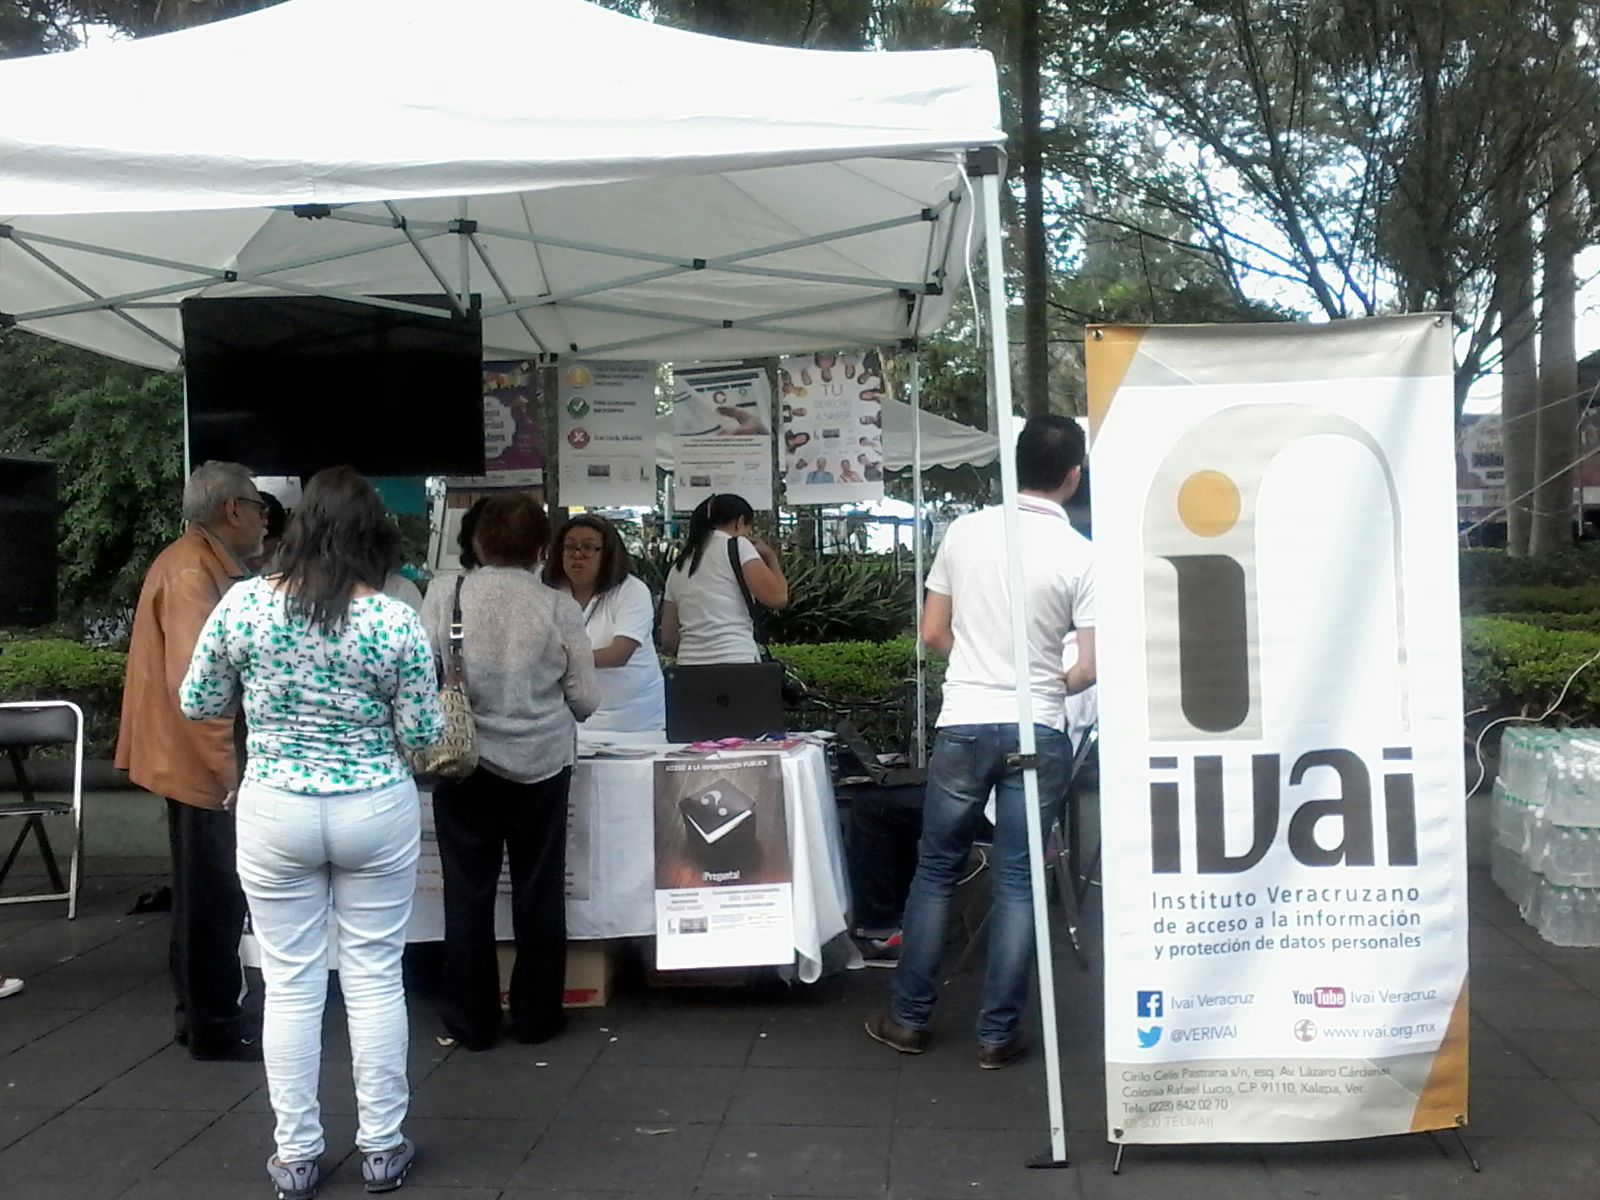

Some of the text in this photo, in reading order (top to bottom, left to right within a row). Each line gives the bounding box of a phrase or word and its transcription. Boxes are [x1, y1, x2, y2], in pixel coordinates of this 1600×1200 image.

[1149, 747, 1419, 875] ivai
[1152, 886, 1420, 910] Instituto Veracruzano
[1153, 909, 1420, 934] de acceso a la información
[1154, 933, 1421, 960] y protección de datos personales
[1171, 994, 1255, 1010] Ivai Veracruz
[1351, 989, 1437, 1004] Ivai Veracruz
[1170, 1026, 1237, 1043] @VERIVAI
[1323, 1023, 1437, 1039] www.ivai.org.mx
[1299, 1065, 1337, 1078] Lázaro
[1166, 1084, 1199, 1095] Rafael
